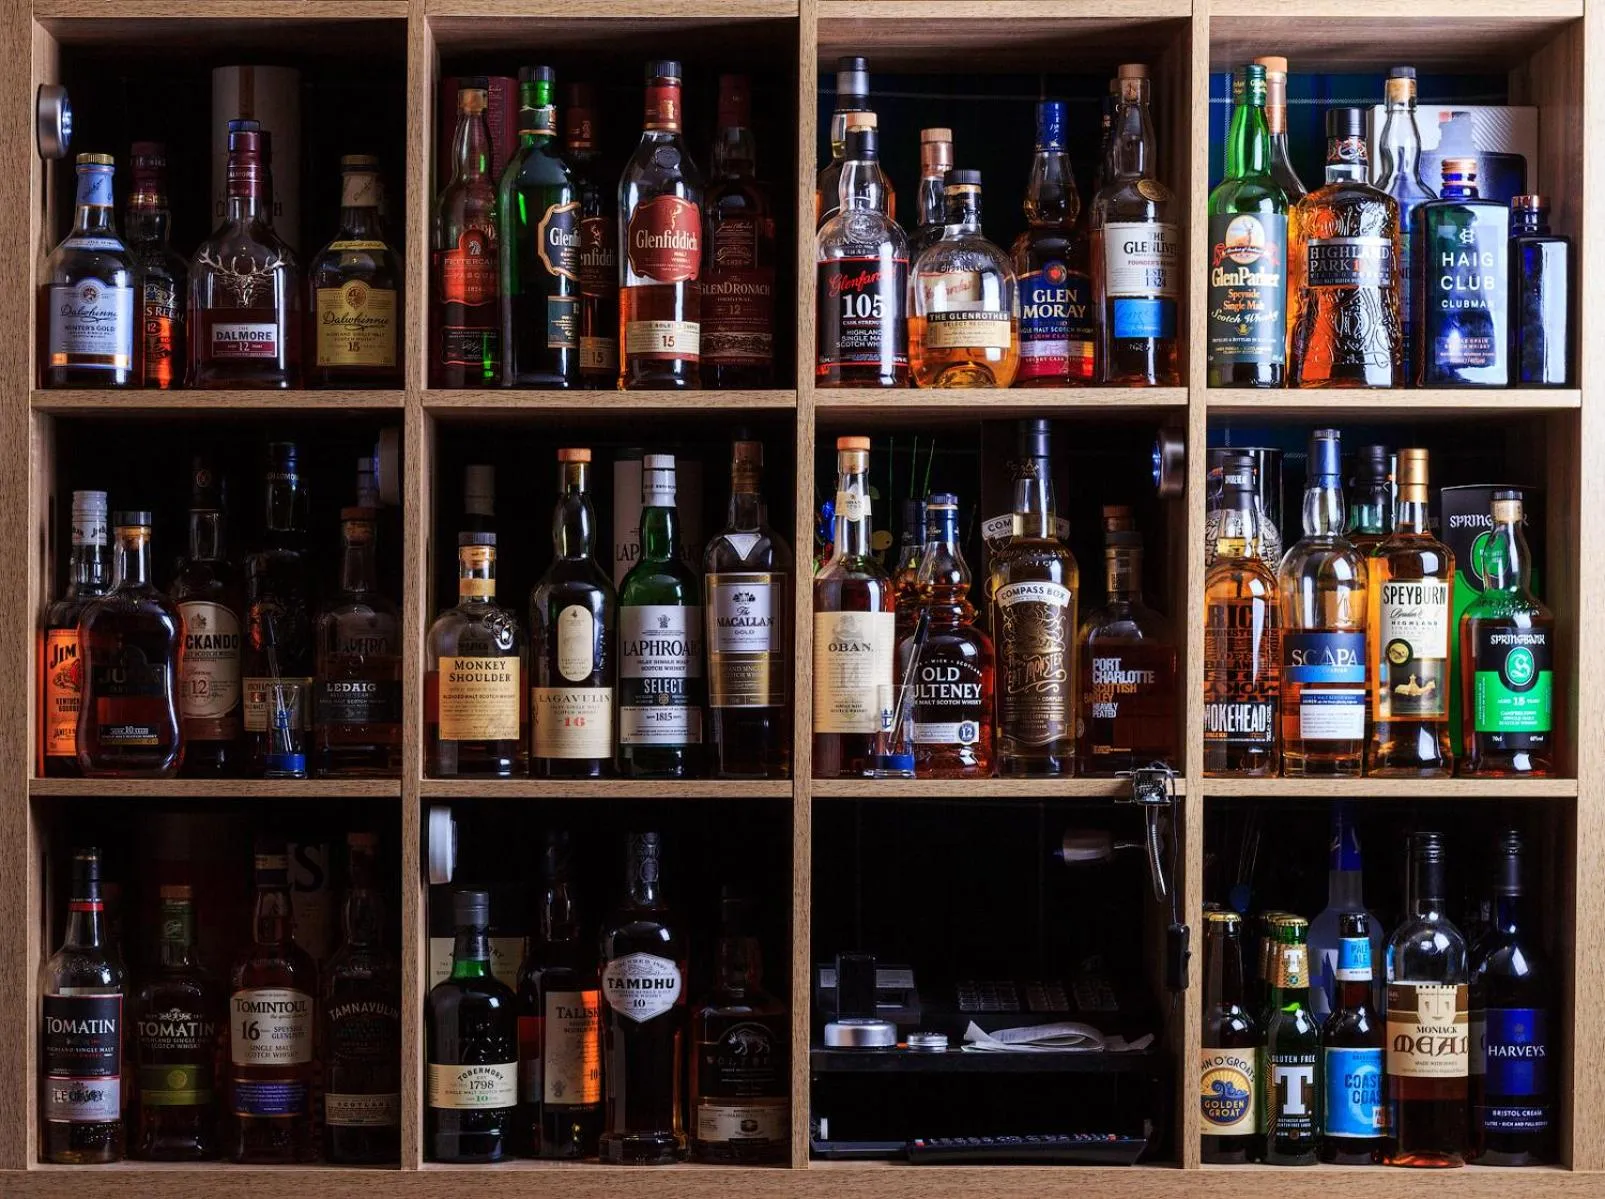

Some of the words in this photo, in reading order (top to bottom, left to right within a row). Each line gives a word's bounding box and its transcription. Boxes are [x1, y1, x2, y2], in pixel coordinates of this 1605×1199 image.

[636, 229, 698, 250] Glenfiddich
[1310, 246, 1390, 260] HIGHLD
[1441, 251, 1494, 267] HAIG
[1310, 260, 1351, 273] PARK
[1440, 276, 1495, 291] CLUB
[1033, 290, 1078, 303] GLEN
[730, 305, 741, 315] 12
[843, 294, 884, 318] 105
[1024, 304, 1086, 320] MORAY
[322, 311, 389, 325] Dalwhinnie
[929, 314, 947, 322] THE
[950, 312, 1008, 321] GLENROTHES
[1212, 310, 1242, 323] Scotch
[216, 331, 273, 341] DALMORE
[662, 336, 675, 348] 15
[841, 336, 868, 344] SINGLE
[240, 341, 250, 352] 12
[349, 342, 361, 352] 15
[837, 341, 867, 349] SCOTCH
[1001, 585, 1044, 602] COMPASS
[1383, 586, 1446, 605] SPEYBURN
[717, 617, 774, 628] MACALLAN
[1490, 634, 1546, 645] SPRINGBANK
[829, 643, 871, 653] OBAN
[50, 644, 78, 670] JIM
[1291, 646, 1359, 667] SCAPA
[454, 660, 507, 672] MONKEY
[1092, 658, 1122, 671] PORT
[449, 673, 512, 682] SHOULDER
[922, 667, 960, 682] OLD
[1092, 671, 1155, 685] CHARLOTTE
[195, 680, 209, 695] 12
[326, 683, 377, 693] LEDAIG
[644, 680, 684, 694] SELECT
[1093, 684, 1137, 694] SCOTTISH
[540, 694, 610, 704] LAGAVULIN
[564, 717, 586, 727] 16
[655, 712, 673, 722] 1815
[1283, 950, 1303, 973] T
[608, 978, 675, 990] TAMDHU
[234, 999, 307, 1014] TOMINTOUL
[632, 999, 646, 1008] 10
[328, 1000, 400, 1021] TAMNAVULIN
[46, 1016, 116, 1035] TOMATIN
[138, 1022, 215, 1038] TOMATIN
[242, 1021, 261, 1041] 16
[1415, 1026, 1458, 1034] MONIACK
[1488, 1045, 1546, 1060] HARVEYS
[458, 1068, 504, 1082] TOBERMORY
[470, 1081, 495, 1090] 1798
[1204, 1101, 1245, 1110] GOLDEN
[1208, 1109, 1241, 1118] GROAT
[1492, 1110, 1520, 1118] BRISTOL
[1521, 1110, 1543, 1118] CREAM
